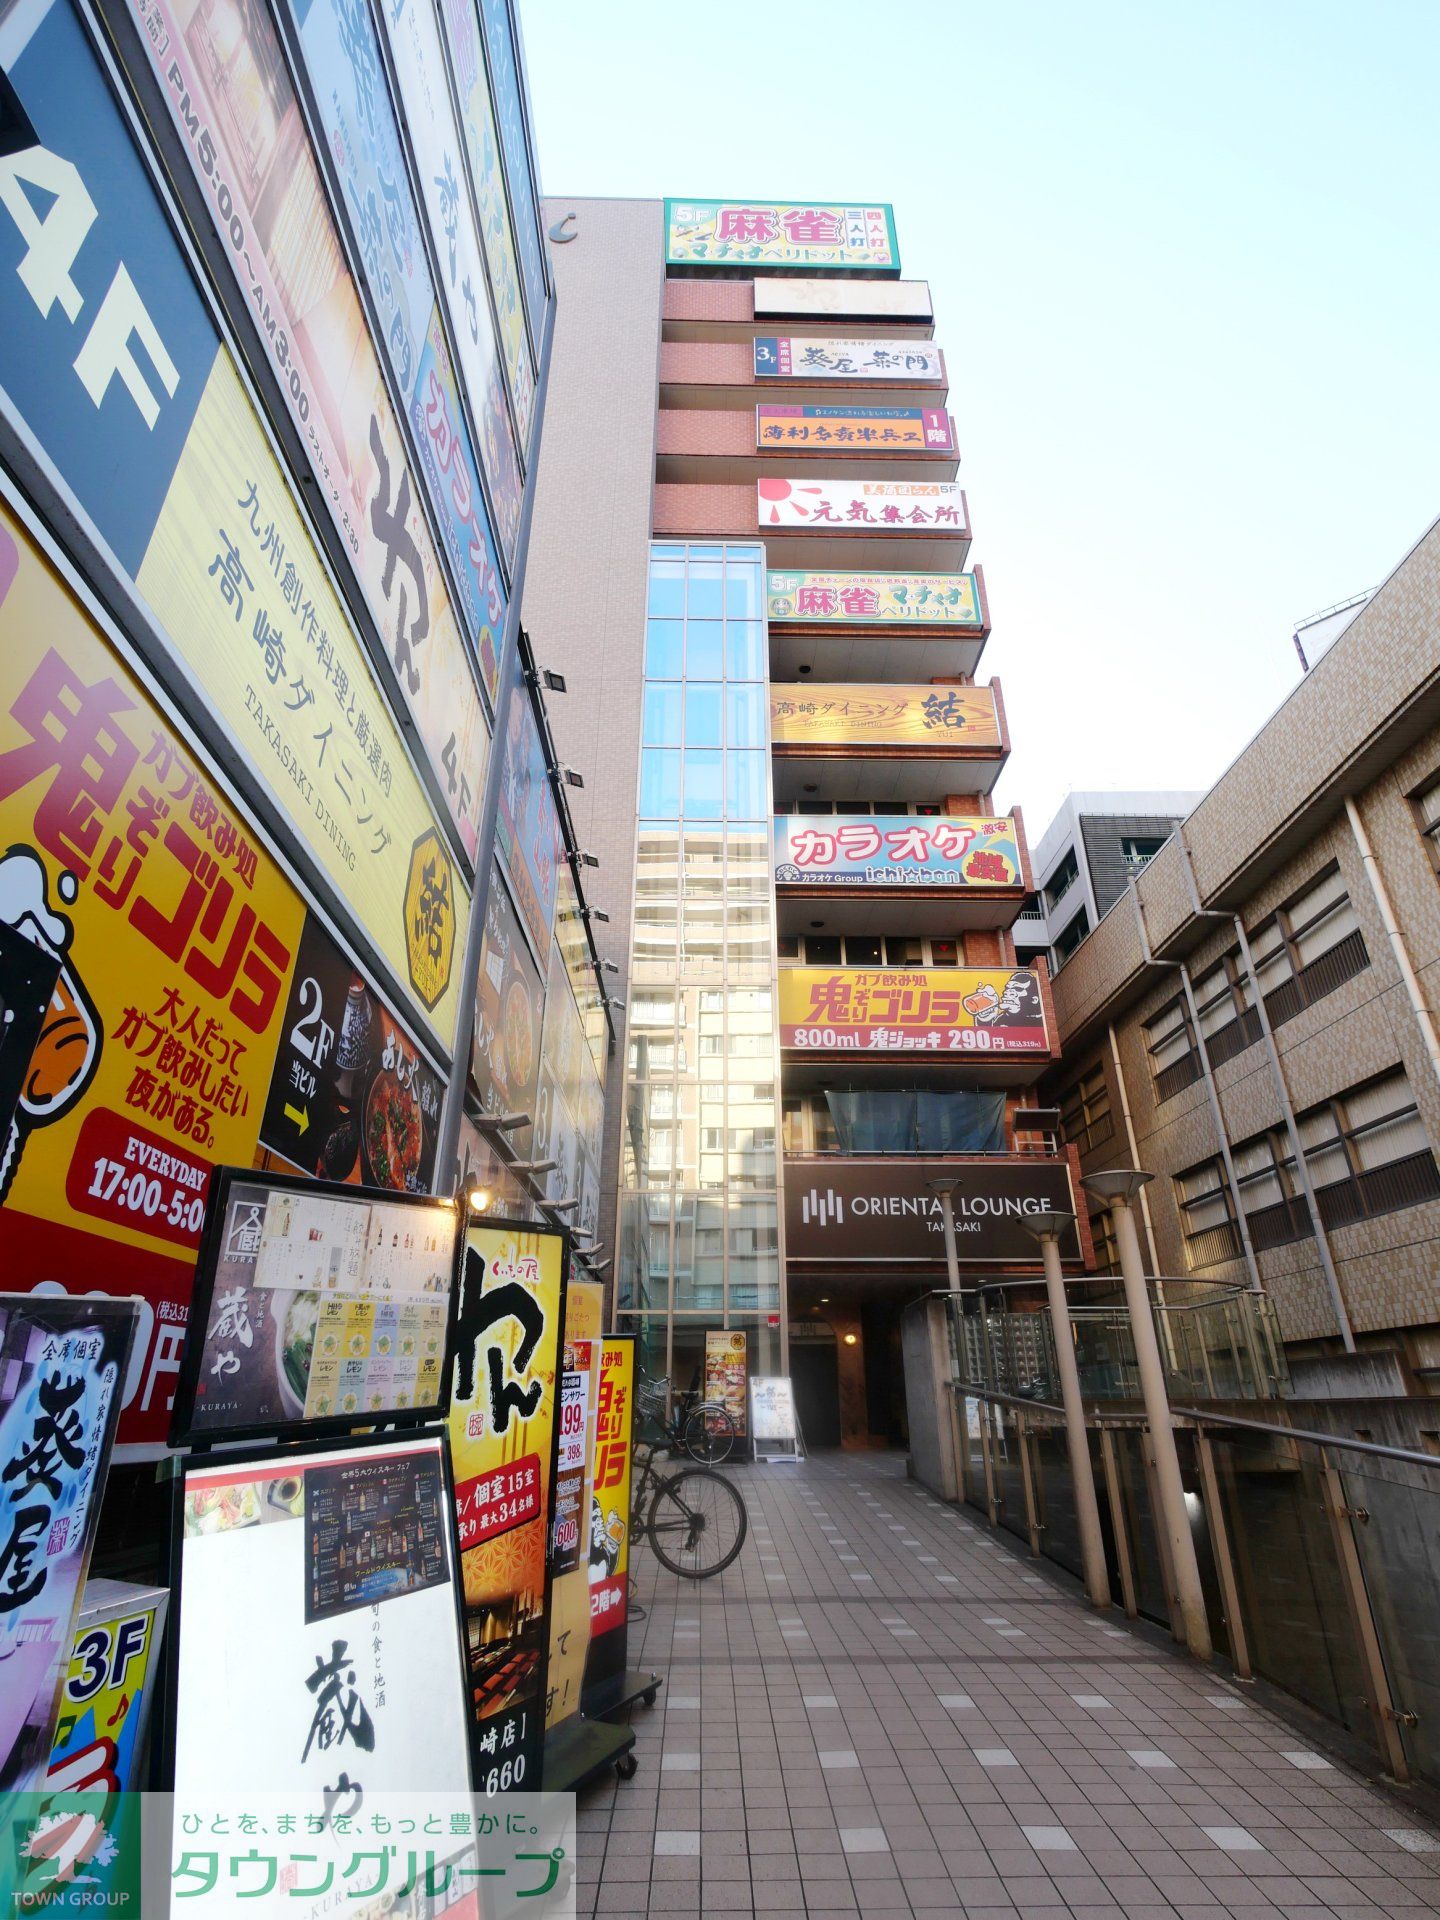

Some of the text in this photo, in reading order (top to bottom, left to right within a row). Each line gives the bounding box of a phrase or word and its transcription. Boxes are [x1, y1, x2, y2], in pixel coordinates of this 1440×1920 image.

[675, 207, 711, 222] 5F
[716, 206, 842, 245] 麻雀
[866, 211, 885, 248] 四人打
[757, 347, 777, 364] 3F
[928, 414, 947, 443] 1階
[940, 485, 958, 494] 5F
[809, 500, 959, 525] 元気集会所
[770, 575, 798, 592] 5F
[797, 586, 879, 616] 麻雀
[208, 528, 393, 855] 高崎ダイニング
[776, 701, 909, 716] 高崎ダイニング
[920, 691, 966, 730] 結
[244, 684, 356, 872] TAKASAKI DINING
[440, 731, 473, 820] 4F
[142, 728, 259, 891] ガブ飲み処
[791, 824, 978, 867] カラオケ
[802, 873, 832, 882] カラオケ
[834, 873, 864, 884] Group
[855, 974, 928, 987] ガブ飲み処
[154, 986, 248, 1077] 大人だって
[290, 977, 335, 1070] 2F
[794, 1029, 860, 1048] 800ml
[868, 1029, 943, 1049] 鬼ジョッキ
[948, 1030, 1005, 1050] 290円
[111, 1005, 250, 1118] ガブ飲みしたい
[125, 1065, 216, 1149] 夜がある。
[123, 1136, 208, 1193] EVERYDAY
[87, 1157, 207, 1233] 17:00-5:0
[851, 1198, 955, 1216] ORIENTA
[926, 1221, 981, 1232] TAKSAKI
[43, 1338, 102, 1362] 全席個室
[208, 1286, 254, 1386] 蔵や
[455, 1246, 544, 1434] わん
[201, 1402, 238, 1412] KURAYA
[66, 1614, 148, 1704] 3F
